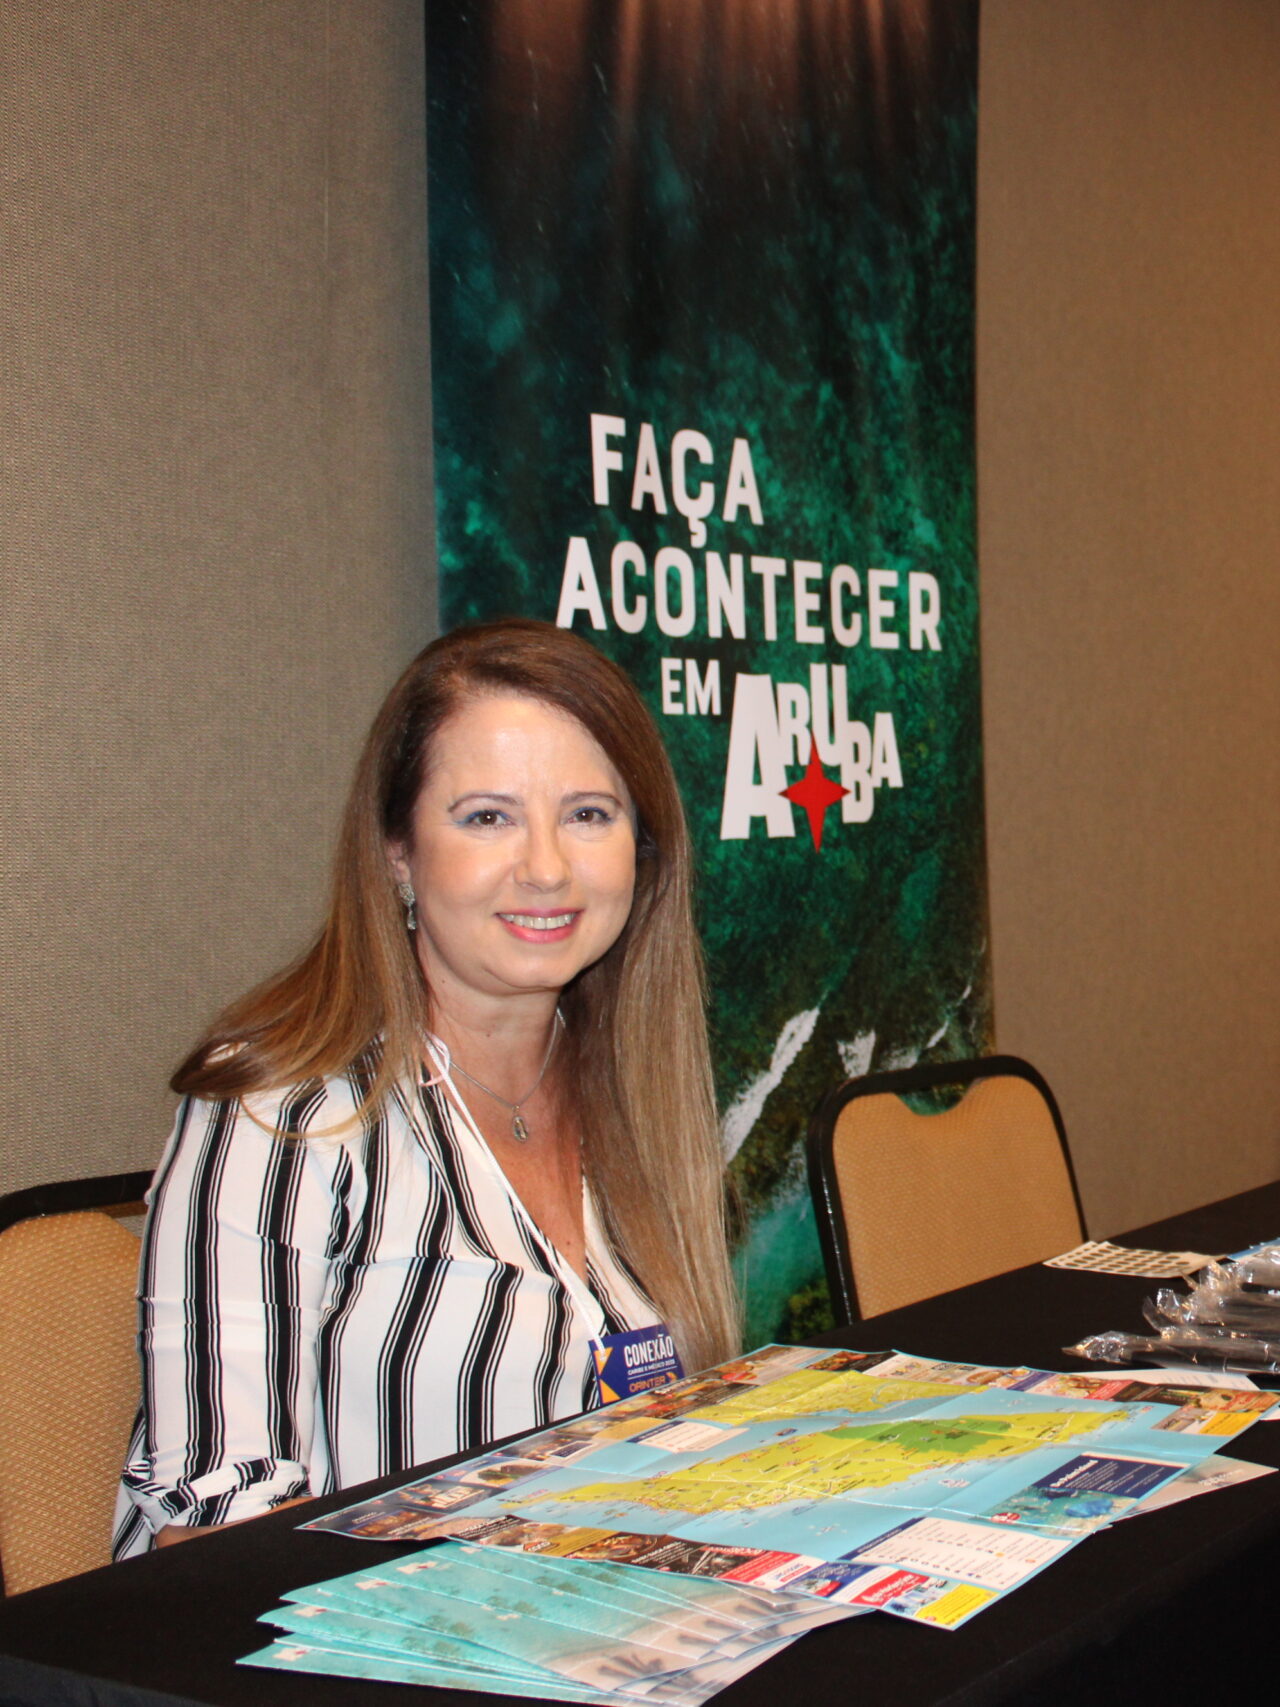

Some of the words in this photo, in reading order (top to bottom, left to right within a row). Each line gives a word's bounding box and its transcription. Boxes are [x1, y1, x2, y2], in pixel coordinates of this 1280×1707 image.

[590, 413, 764, 547] FAÇA
[556, 536, 942, 651] ACONTECER
[661, 657, 721, 715] EM
[720, 662, 903, 840] ARUBA
[624, 1334, 674, 1367] CONEXÃO
